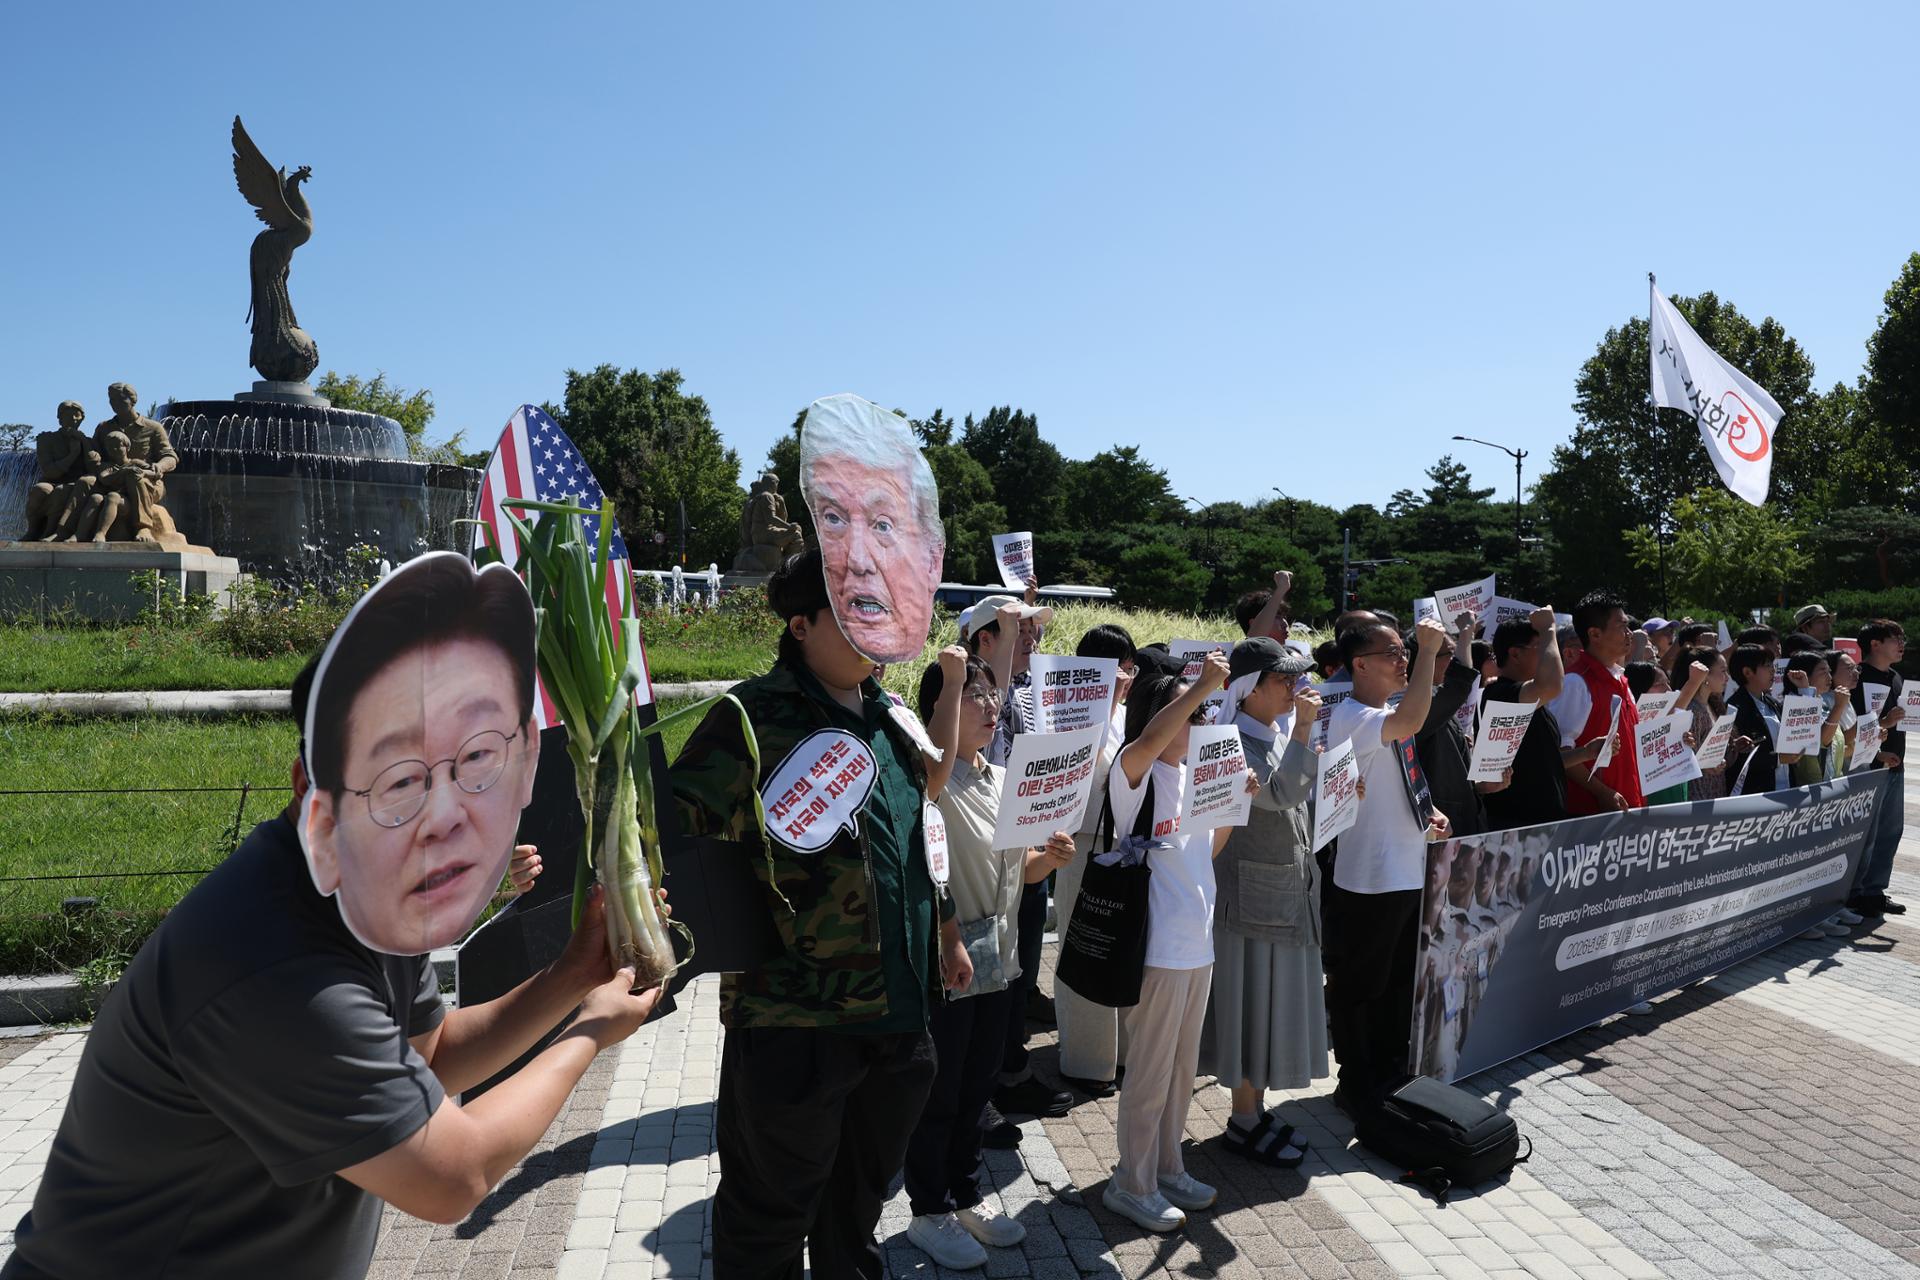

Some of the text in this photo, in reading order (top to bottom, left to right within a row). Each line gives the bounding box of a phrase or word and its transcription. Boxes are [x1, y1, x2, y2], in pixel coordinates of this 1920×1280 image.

[1003, 541, 1022, 553] 이재명
[1044, 668, 1102, 686] 이재명 정부는
[1041, 684, 1109, 708] 평화에 기여하라!
[1051, 707, 1069, 717] Strongly
[1069, 706, 1090, 714] Demand
[1488, 728, 1516, 741] 이재명
[1200, 737, 1239, 762] 이재명 정부는
[1025, 754, 1069, 777] 이란에서
[1193, 762, 1217, 786] 평화에
[768, 740, 850, 821] 자국의 석유는
[1017, 779, 1043, 798] 이란
[1043, 774, 1064, 794] 공격
[1065, 769, 1080, 785] 즉각
[785, 754, 871, 840] 자국이 지켜라!
[1030, 799, 1057, 812] Hands
[1057, 795, 1067, 806] Off
[1016, 815, 1037, 826] Stop
[1038, 812, 1052, 822] the
[1541, 840, 1604, 895] 이재명
[1604, 830, 1656, 881] 정부의
[1656, 823, 1709, 869] 한국군
[1703, 816, 1768, 856] 호르무즈
[1761, 808, 1796, 844] 파병
[1787, 803, 1817, 839] 규탄
[1538, 905, 1582, 930] Emergency
[1581, 902, 1603, 919] Press
[1603, 892, 1644, 913] Conference
[1643, 881, 1683, 902] Condemning
[1683, 878, 1693, 892] the
[1693, 876, 1704, 890] Lee
[1704, 866, 1749, 886] Administration's
[1749, 856, 1778, 877] Deployment
[1778, 855, 1784, 868] of
[1784, 851, 1799, 867] South
[1081, 902, 1113, 917] VINTAGE
[1559, 992, 1585, 1008] Alliance
[1593, 980, 1611, 995] Social
[1633, 980, 1652, 997] Urgent
